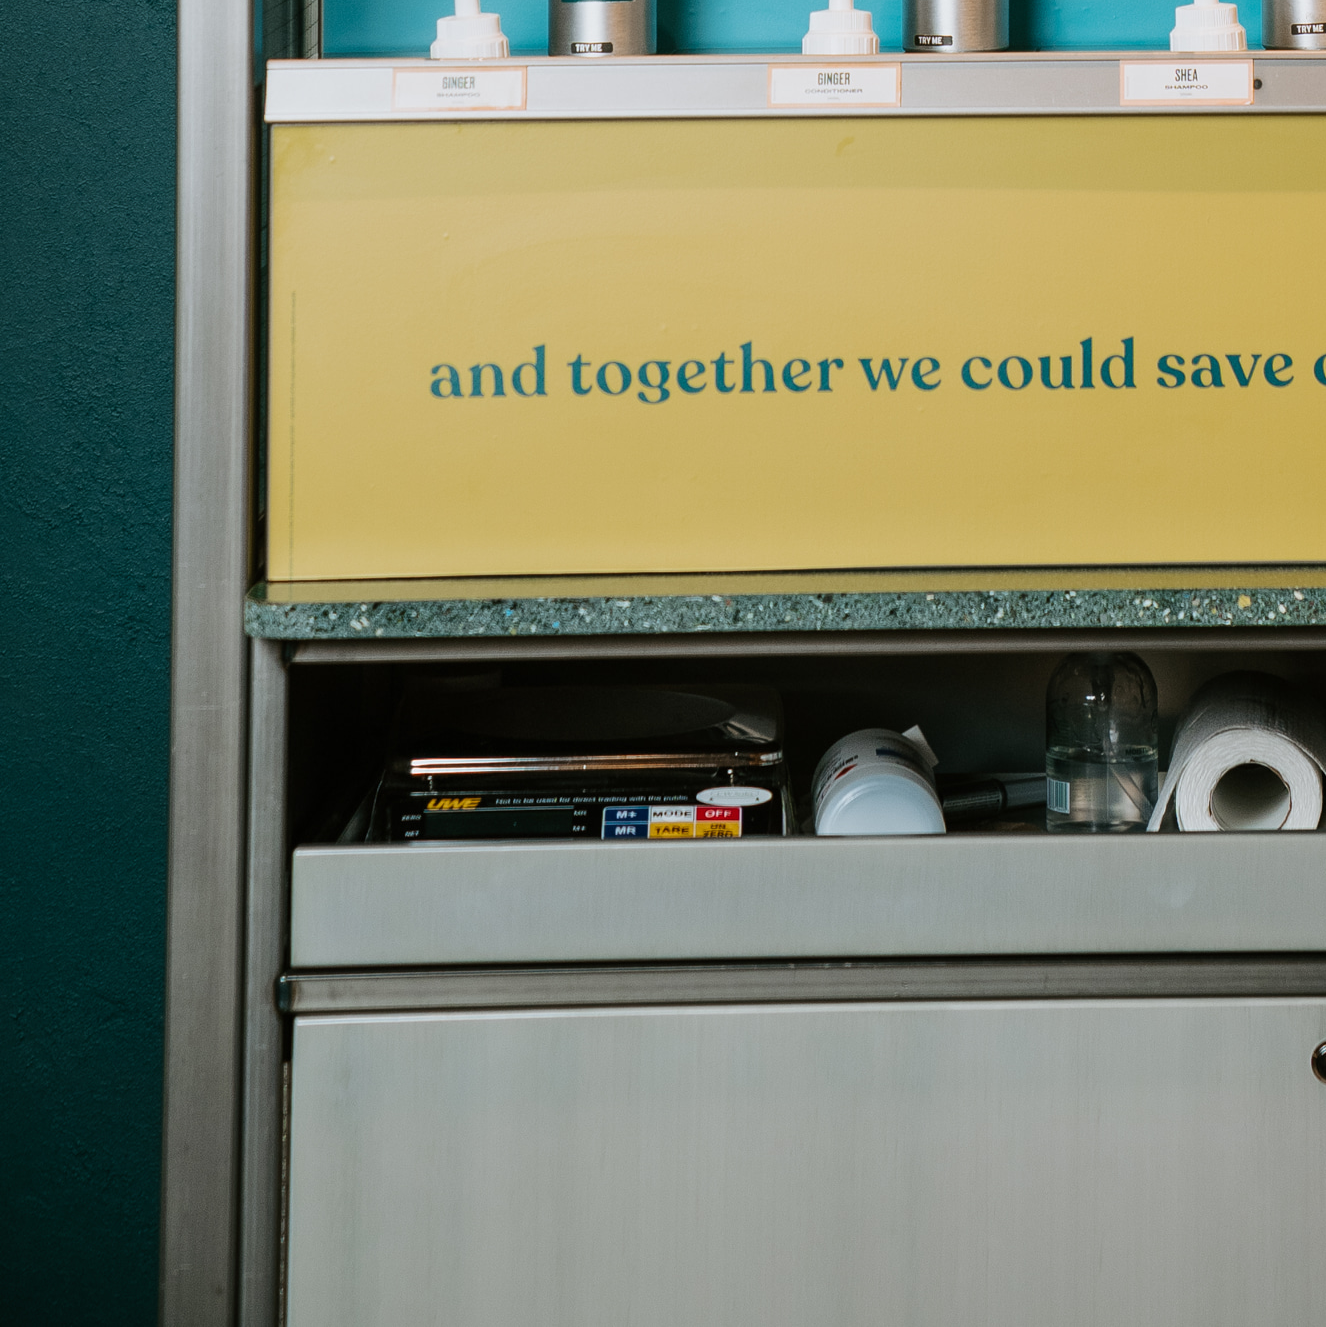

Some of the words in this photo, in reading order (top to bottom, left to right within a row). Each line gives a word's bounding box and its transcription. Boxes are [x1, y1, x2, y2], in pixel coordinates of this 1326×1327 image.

[817, 73, 851, 85] GINGER
[1174, 69, 1199, 82] SHEA
[430, 344, 547, 398] and
[567, 341, 844, 404] together
[858, 357, 941, 391] we
[961, 336, 1137, 390] could
[1156, 353, 1294, 389] save
[426, 797, 482, 811] UWE
[705, 809, 732, 820] OFF
